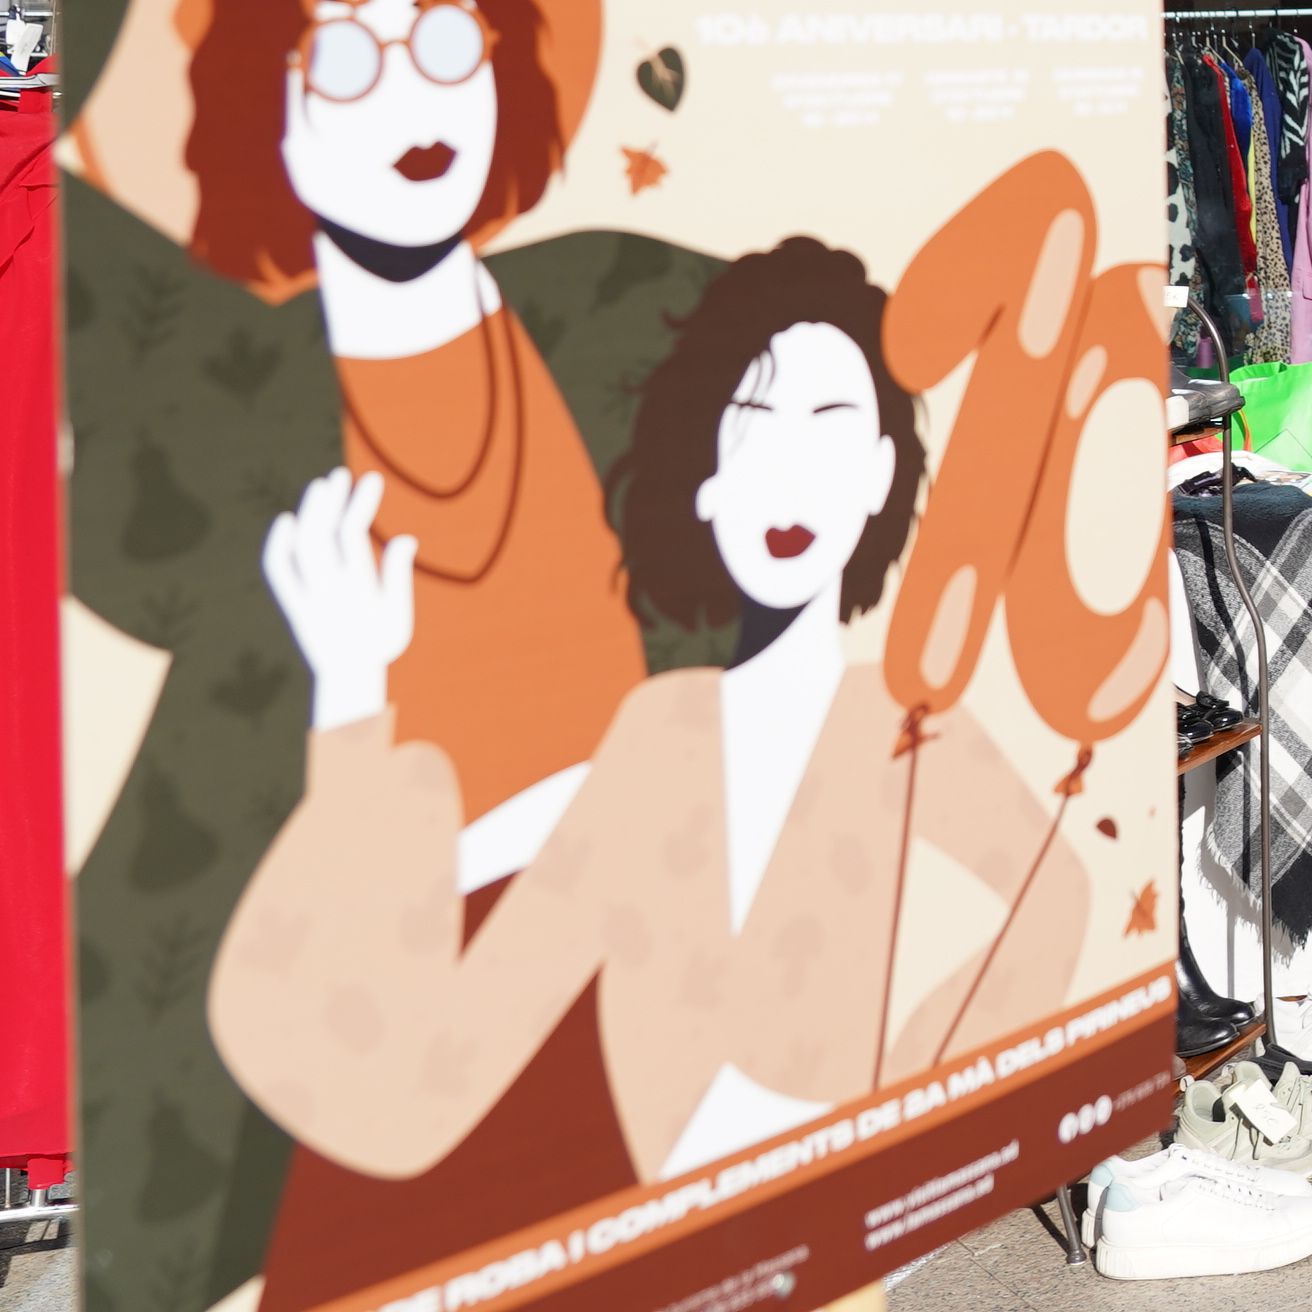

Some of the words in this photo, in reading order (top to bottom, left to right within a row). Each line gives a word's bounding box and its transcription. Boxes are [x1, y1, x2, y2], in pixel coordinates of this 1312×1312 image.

[444, 1239, 568, 1312] ROBA
[586, 1119, 856, 1256] COMPLEMENTS
[856, 1099, 902, 1141] DE
[994, 1025, 1066, 1078] DELS
